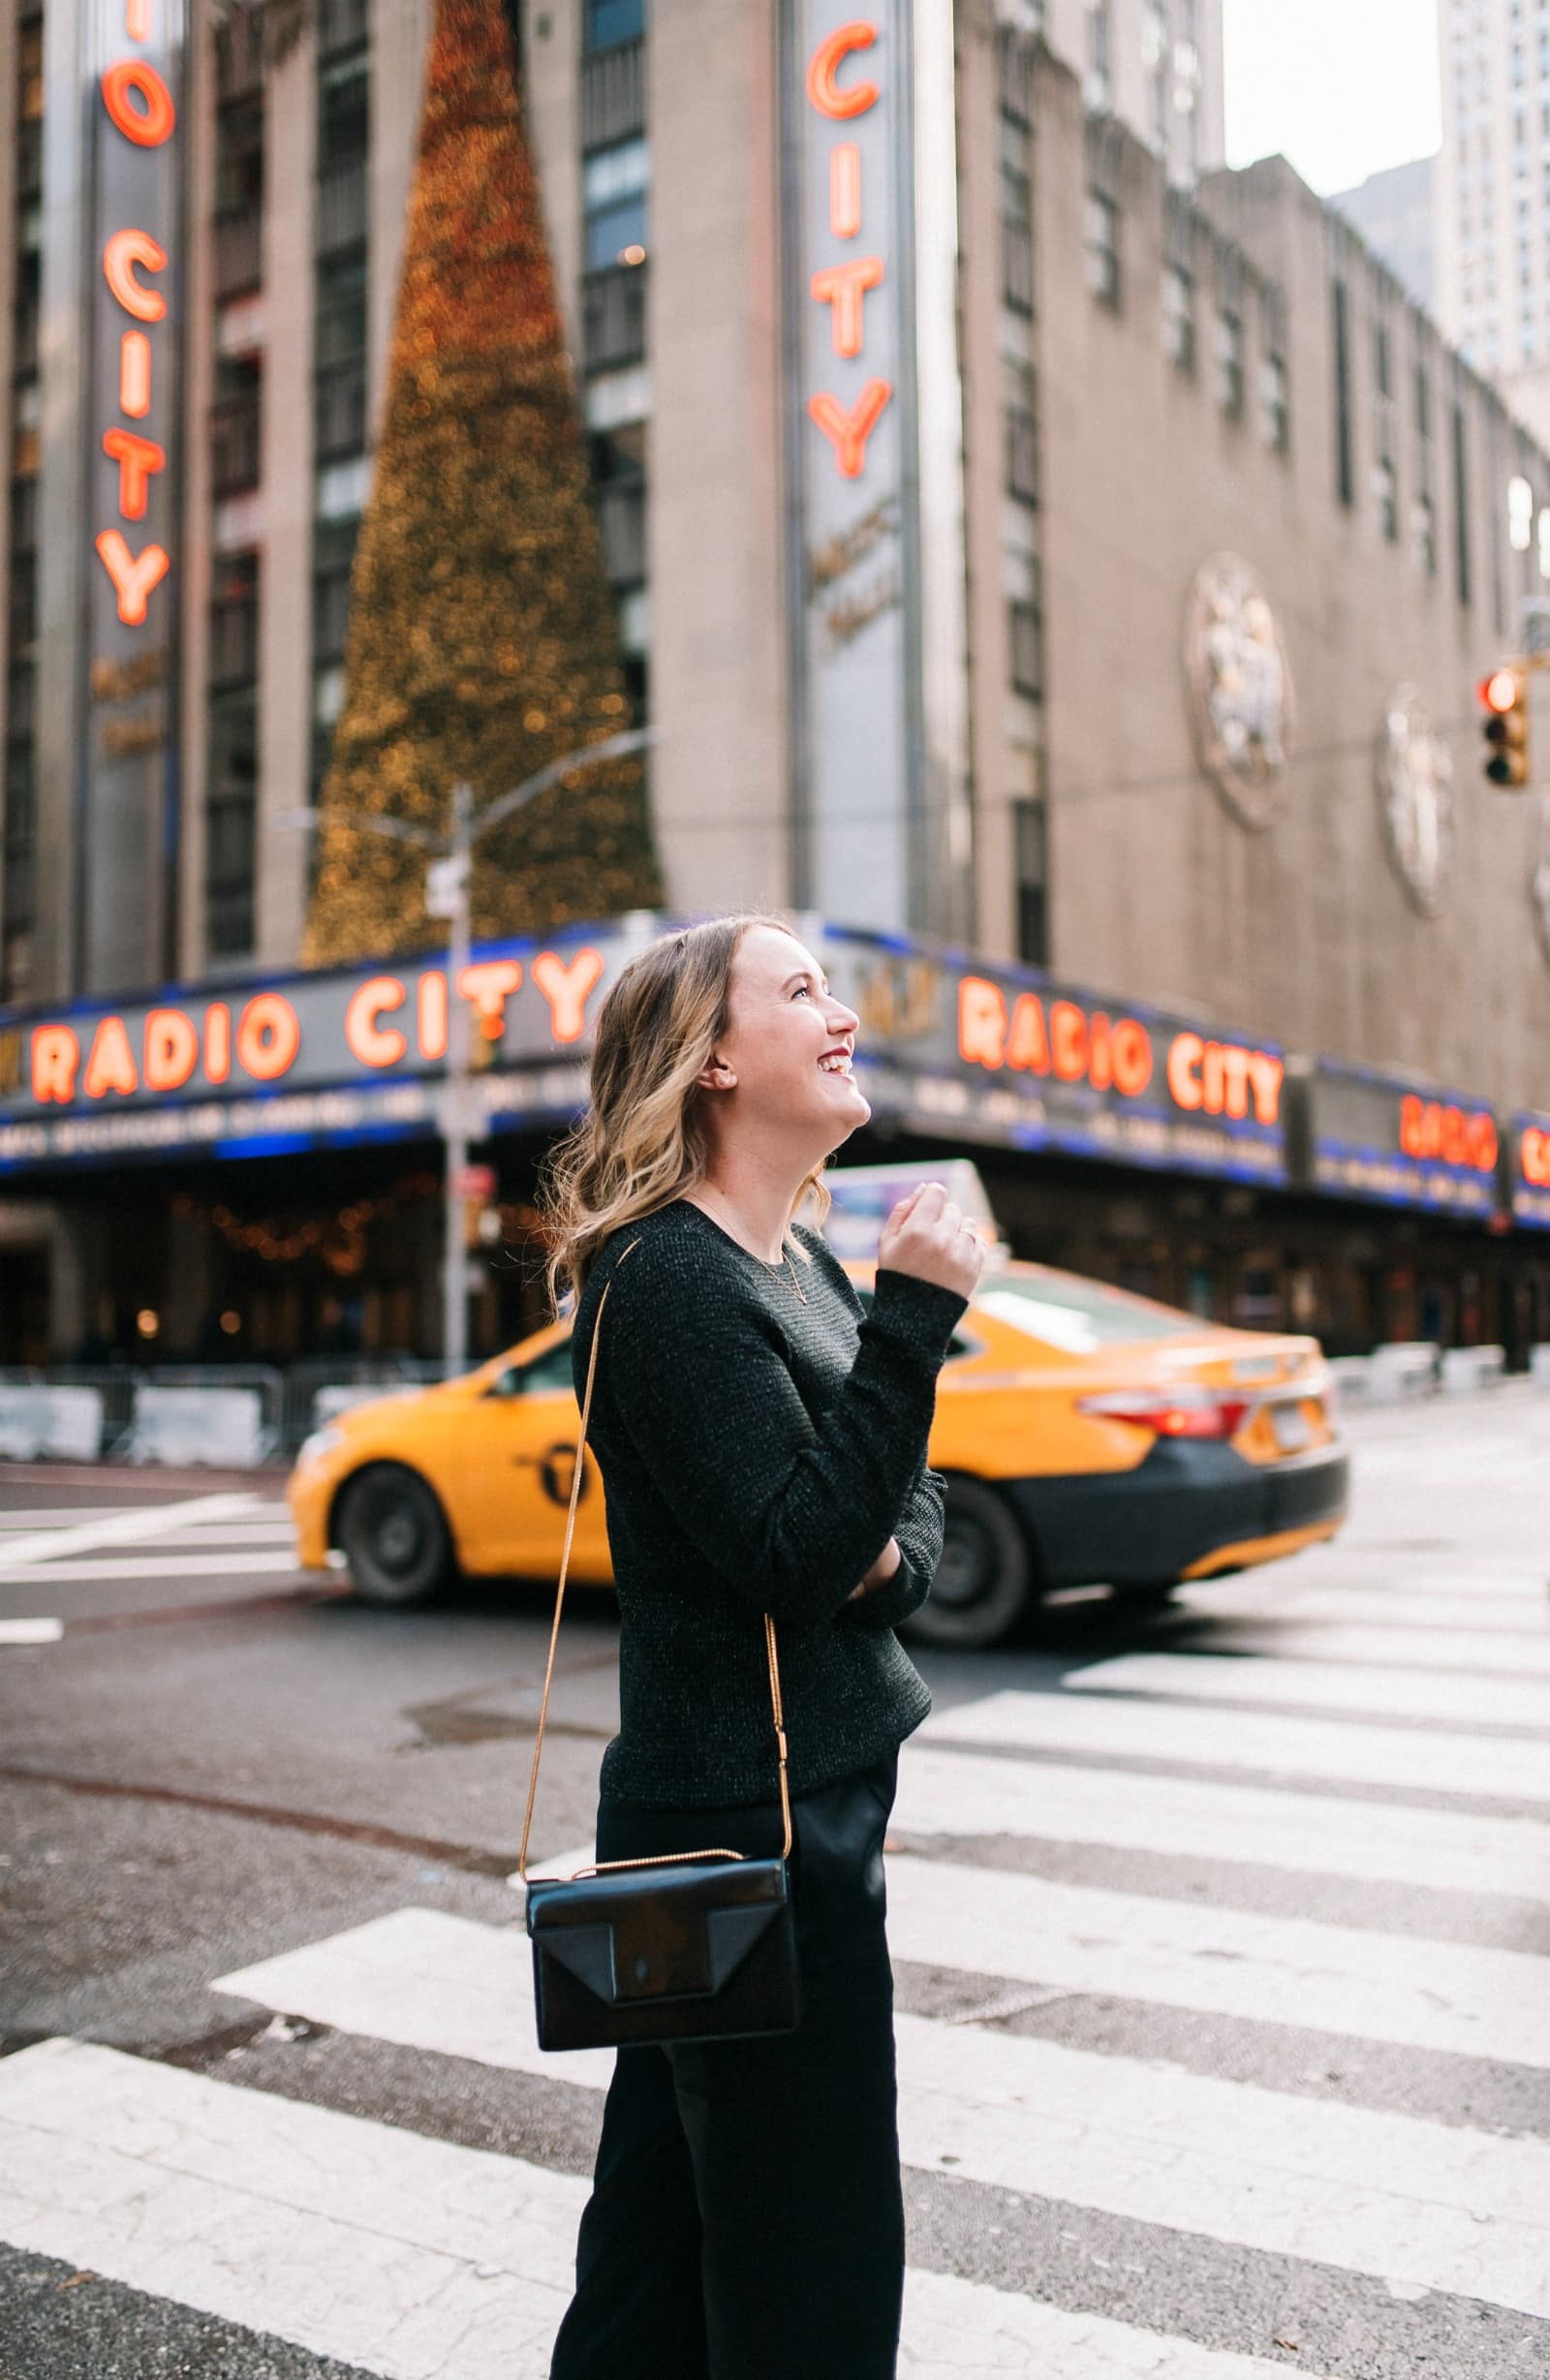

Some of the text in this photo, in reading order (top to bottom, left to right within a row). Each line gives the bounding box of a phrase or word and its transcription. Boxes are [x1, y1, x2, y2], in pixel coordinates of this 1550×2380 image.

[806, 19, 892, 479] CITY
[95, 228, 170, 627] CITY
[31, 992, 300, 1104] RADIO
[345, 946, 604, 1067] CITY
[958, 975, 1153, 1097] RADIO
[1166, 1032, 1285, 1127] CITY
